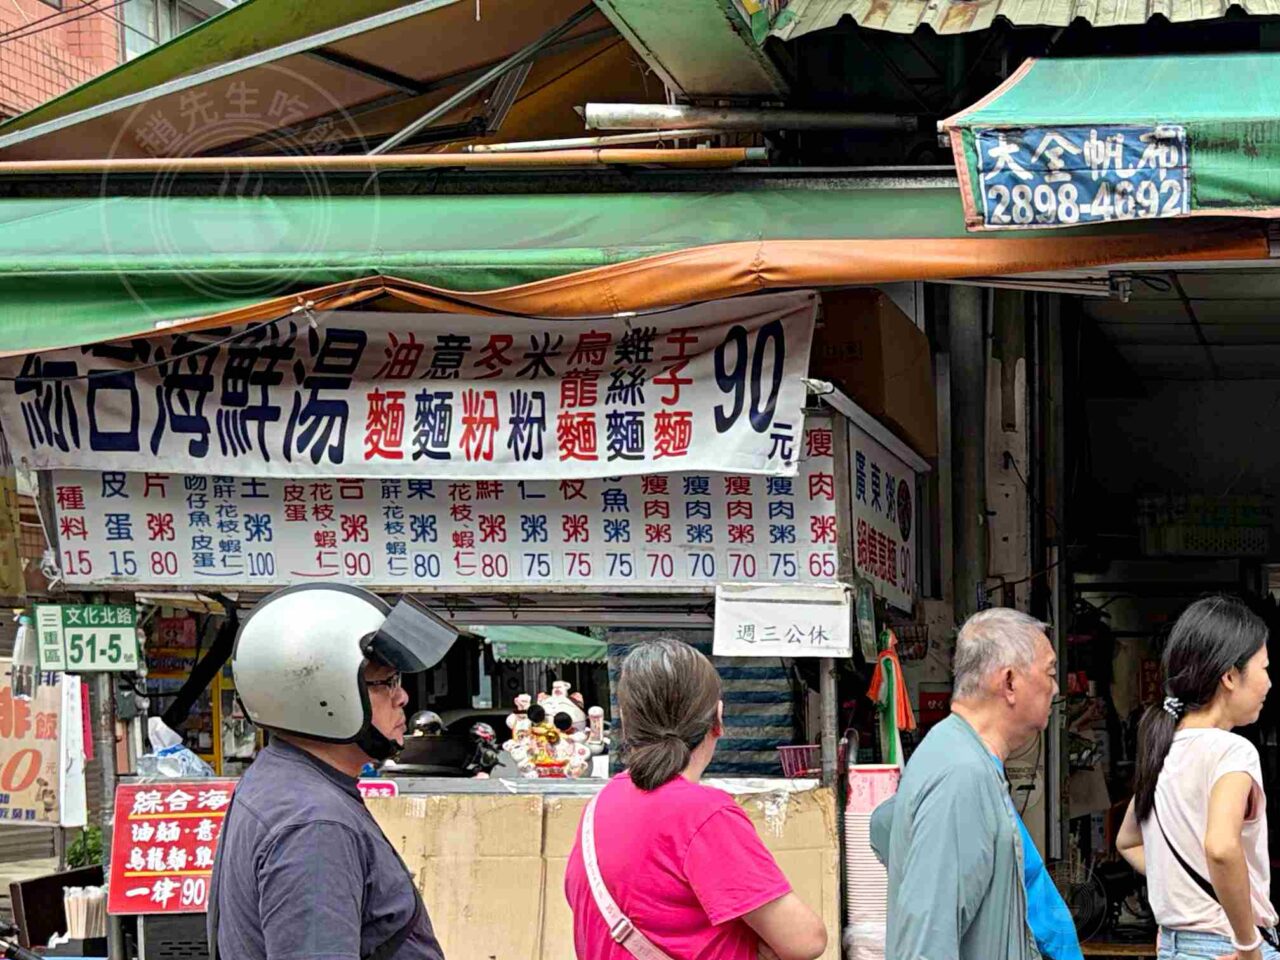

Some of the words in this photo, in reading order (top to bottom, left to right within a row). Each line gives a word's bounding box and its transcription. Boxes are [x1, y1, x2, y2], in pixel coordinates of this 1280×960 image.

[985, 126, 1184, 182] 大全帆布
[601, 476, 630, 543] 魚粥
[64, 550, 92, 576] 15
[109, 550, 137, 576] 15
[151, 551, 178, 575] 80
[249, 552, 275, 577] 100
[344, 552, 371, 576] 90
[414, 553, 440, 578] 80
[481, 554, 508, 578] 80
[523, 553, 550, 577] 75
[565, 553, 591, 576] 75
[605, 553, 632, 577] 75
[647, 553, 674, 577] 70
[688, 553, 715, 577] 70
[729, 553, 756, 577] 70
[769, 553, 796, 577] 75
[809, 553, 836, 577] 65
[66, 607, 132, 625] 文化北路
[736, 623, 830, 645] 週三公休
[131, 818, 224, 842] 油麵·意
